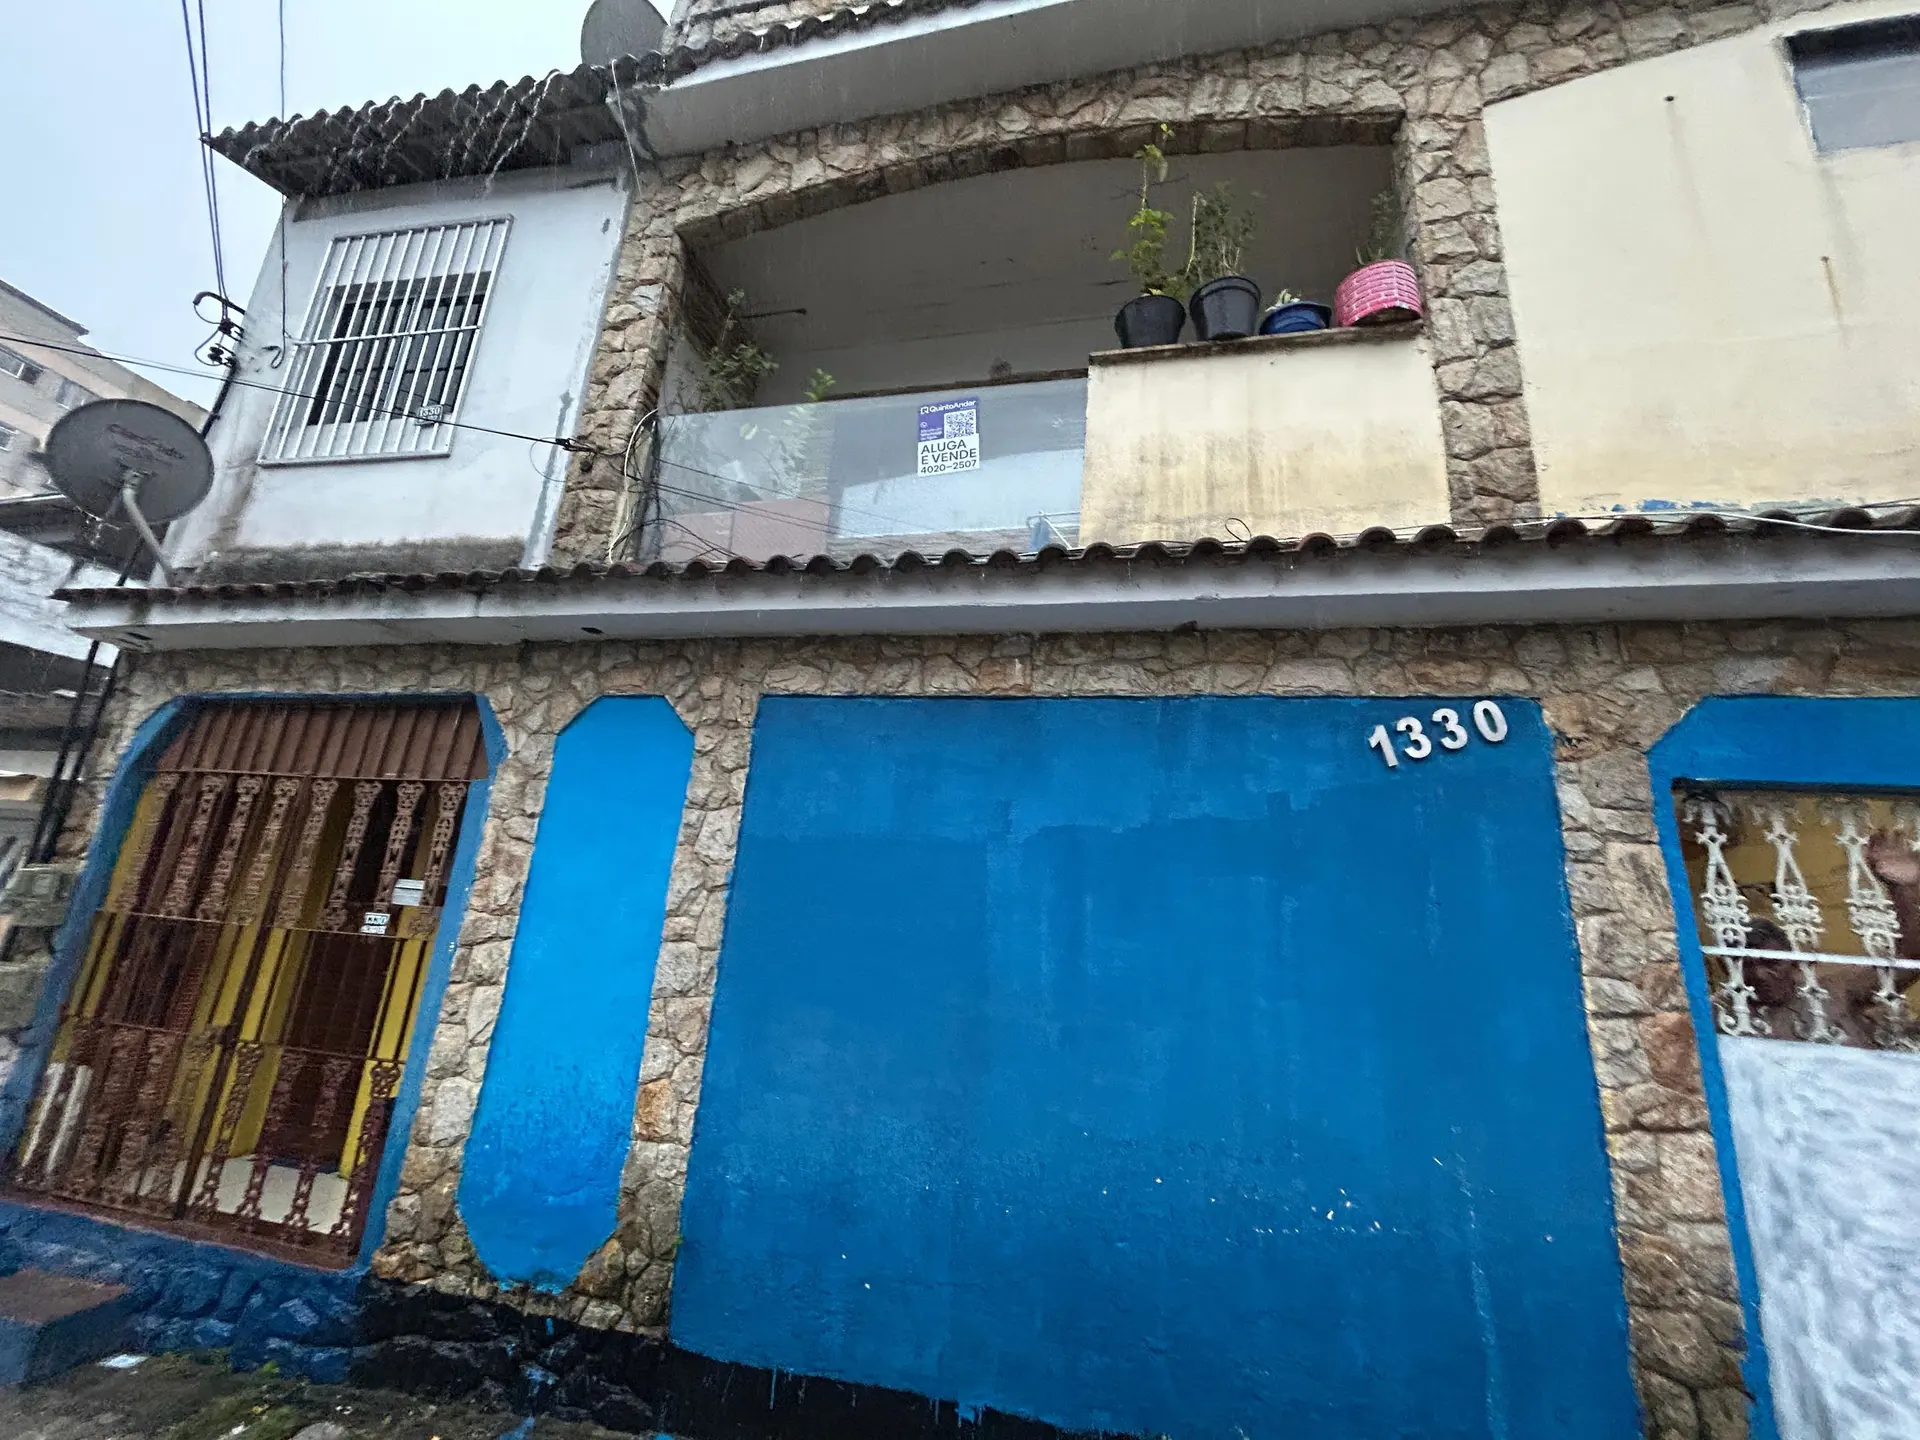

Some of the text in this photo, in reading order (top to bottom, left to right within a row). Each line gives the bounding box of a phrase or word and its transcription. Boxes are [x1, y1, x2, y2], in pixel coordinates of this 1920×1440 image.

[929, 400, 976, 412] QuintoAndar
[921, 439, 966, 454] ALUGA
[921, 448, 976, 465] E VENDE
[921, 459, 976, 473] 4020-2507
[1368, 700, 1508, 767] 1330
